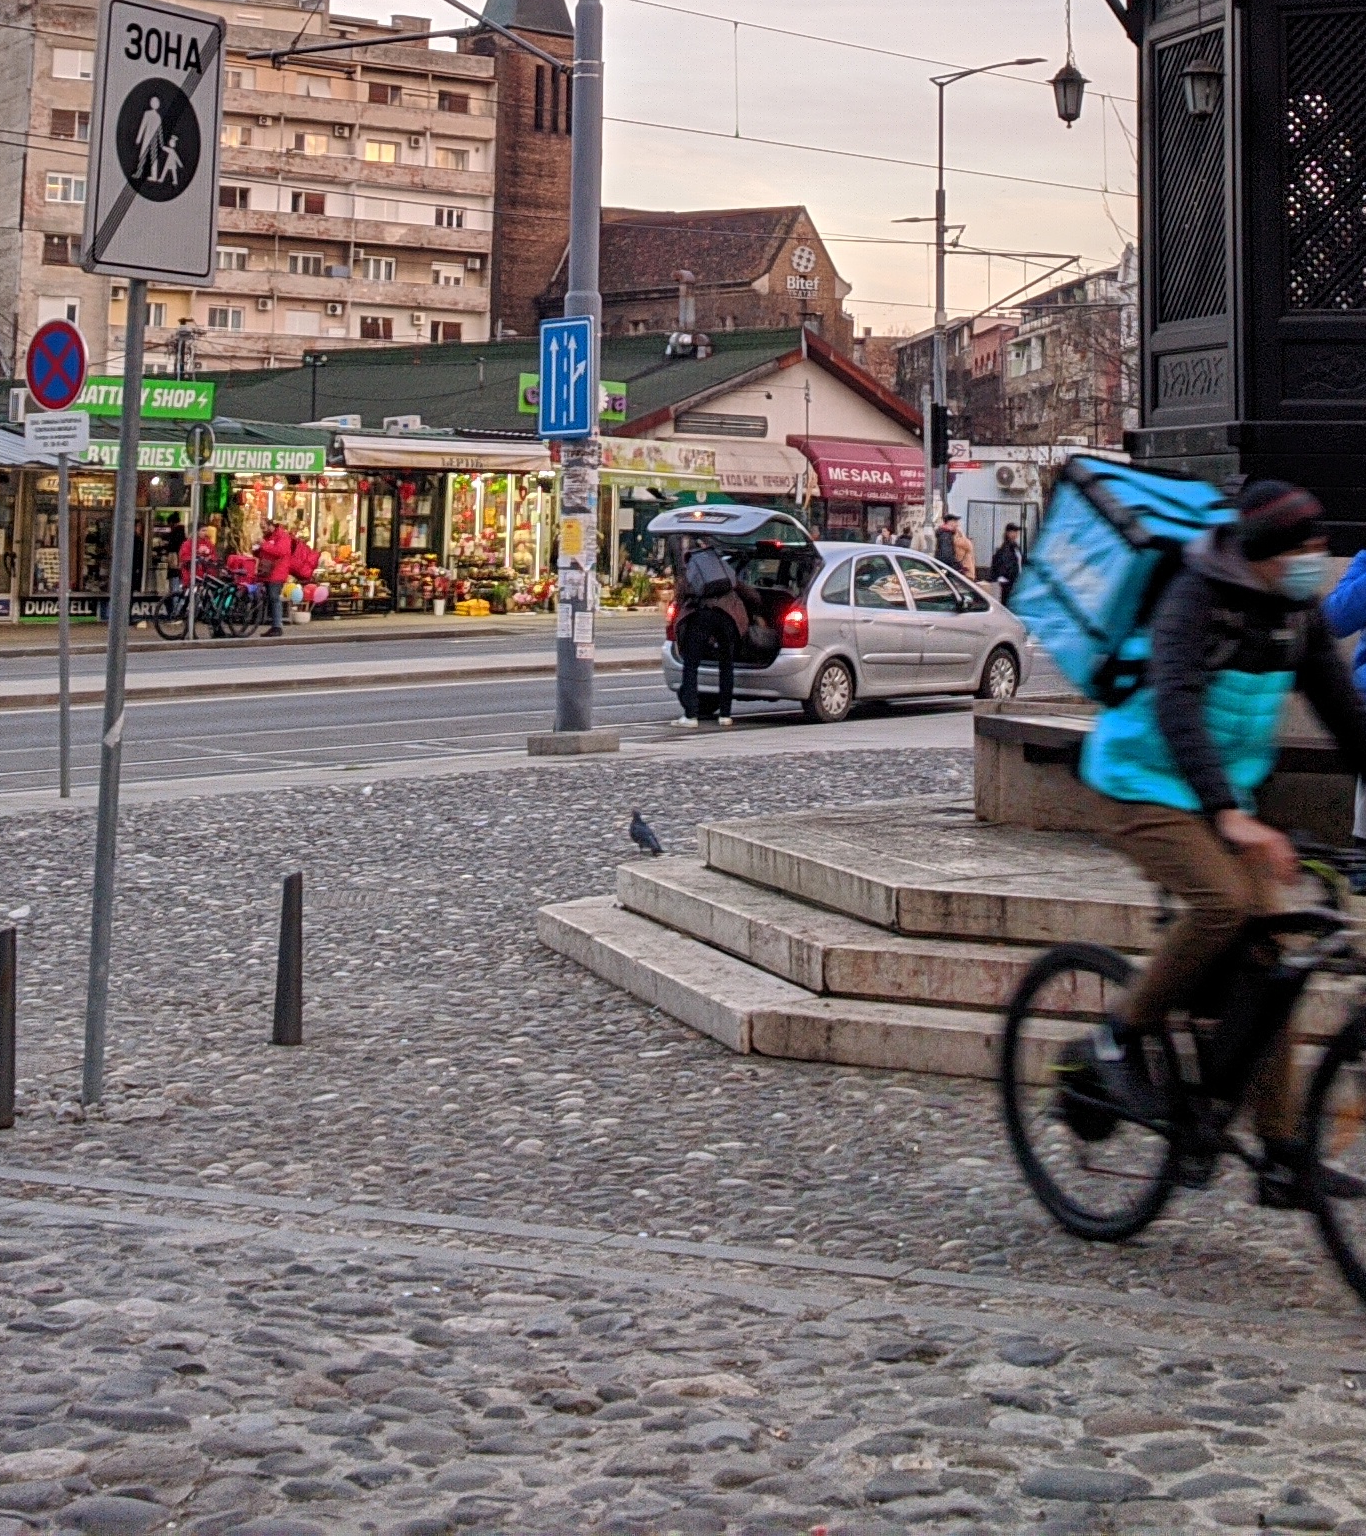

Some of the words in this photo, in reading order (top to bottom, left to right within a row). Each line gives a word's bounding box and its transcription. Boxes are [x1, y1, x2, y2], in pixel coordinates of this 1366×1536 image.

[124, 22, 202, 74] ЗОНА
[786, 275, 819, 290] Bitef
[152, 389, 195, 409] SHOP
[88, 445, 175, 467] BATRIES
[275, 451, 315, 470] SHOP
[828, 467, 894, 484] MESARA
[25, 601, 93, 615] DURAELL
[131, 601, 169, 616] ARTA
